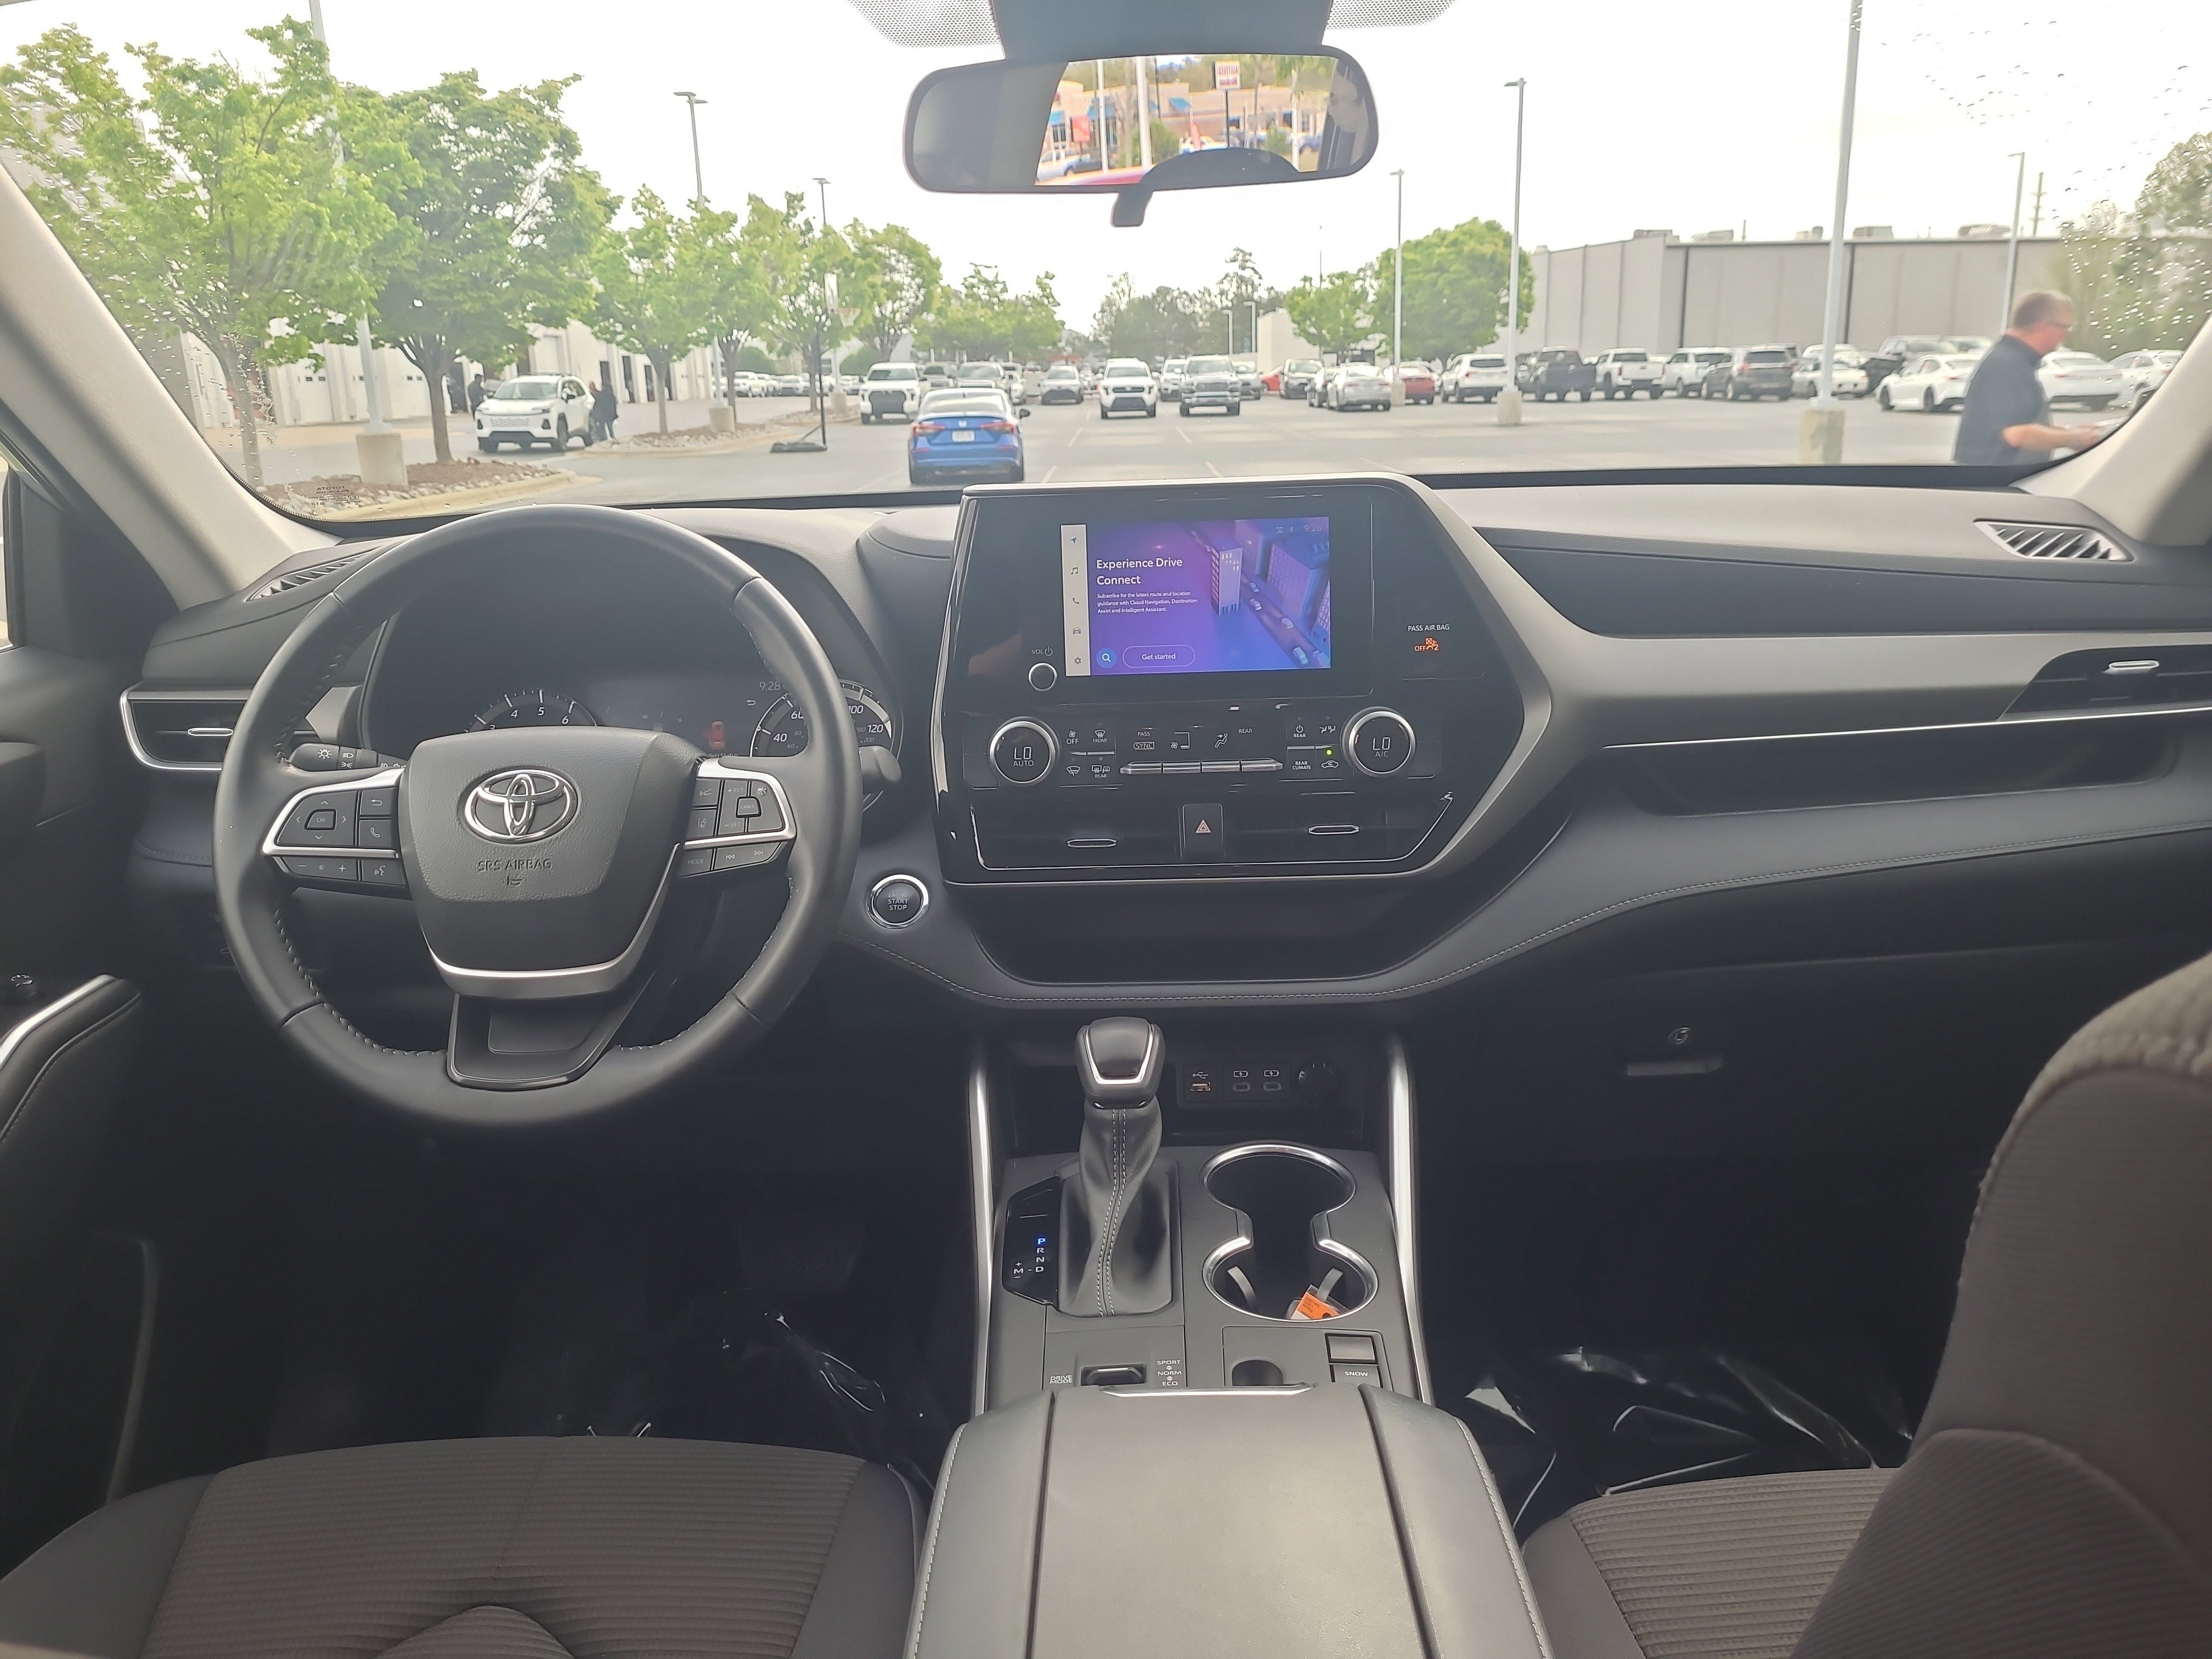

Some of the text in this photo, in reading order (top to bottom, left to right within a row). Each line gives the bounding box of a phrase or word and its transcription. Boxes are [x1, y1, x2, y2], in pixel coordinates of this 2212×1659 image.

[1096, 557, 1183, 571] Experience Drive
[1097, 575, 1141, 585] Connect
[759, 681, 781, 690] 9:28
[510, 709, 518, 718] 4
[537, 707, 545, 716] 5
[848, 705, 864, 714] 100
[561, 715, 569, 724] 6
[867, 724, 884, 733] 120
[773, 733, 787, 742] 40
[477, 857, 552, 872] SRS AIRBAG
